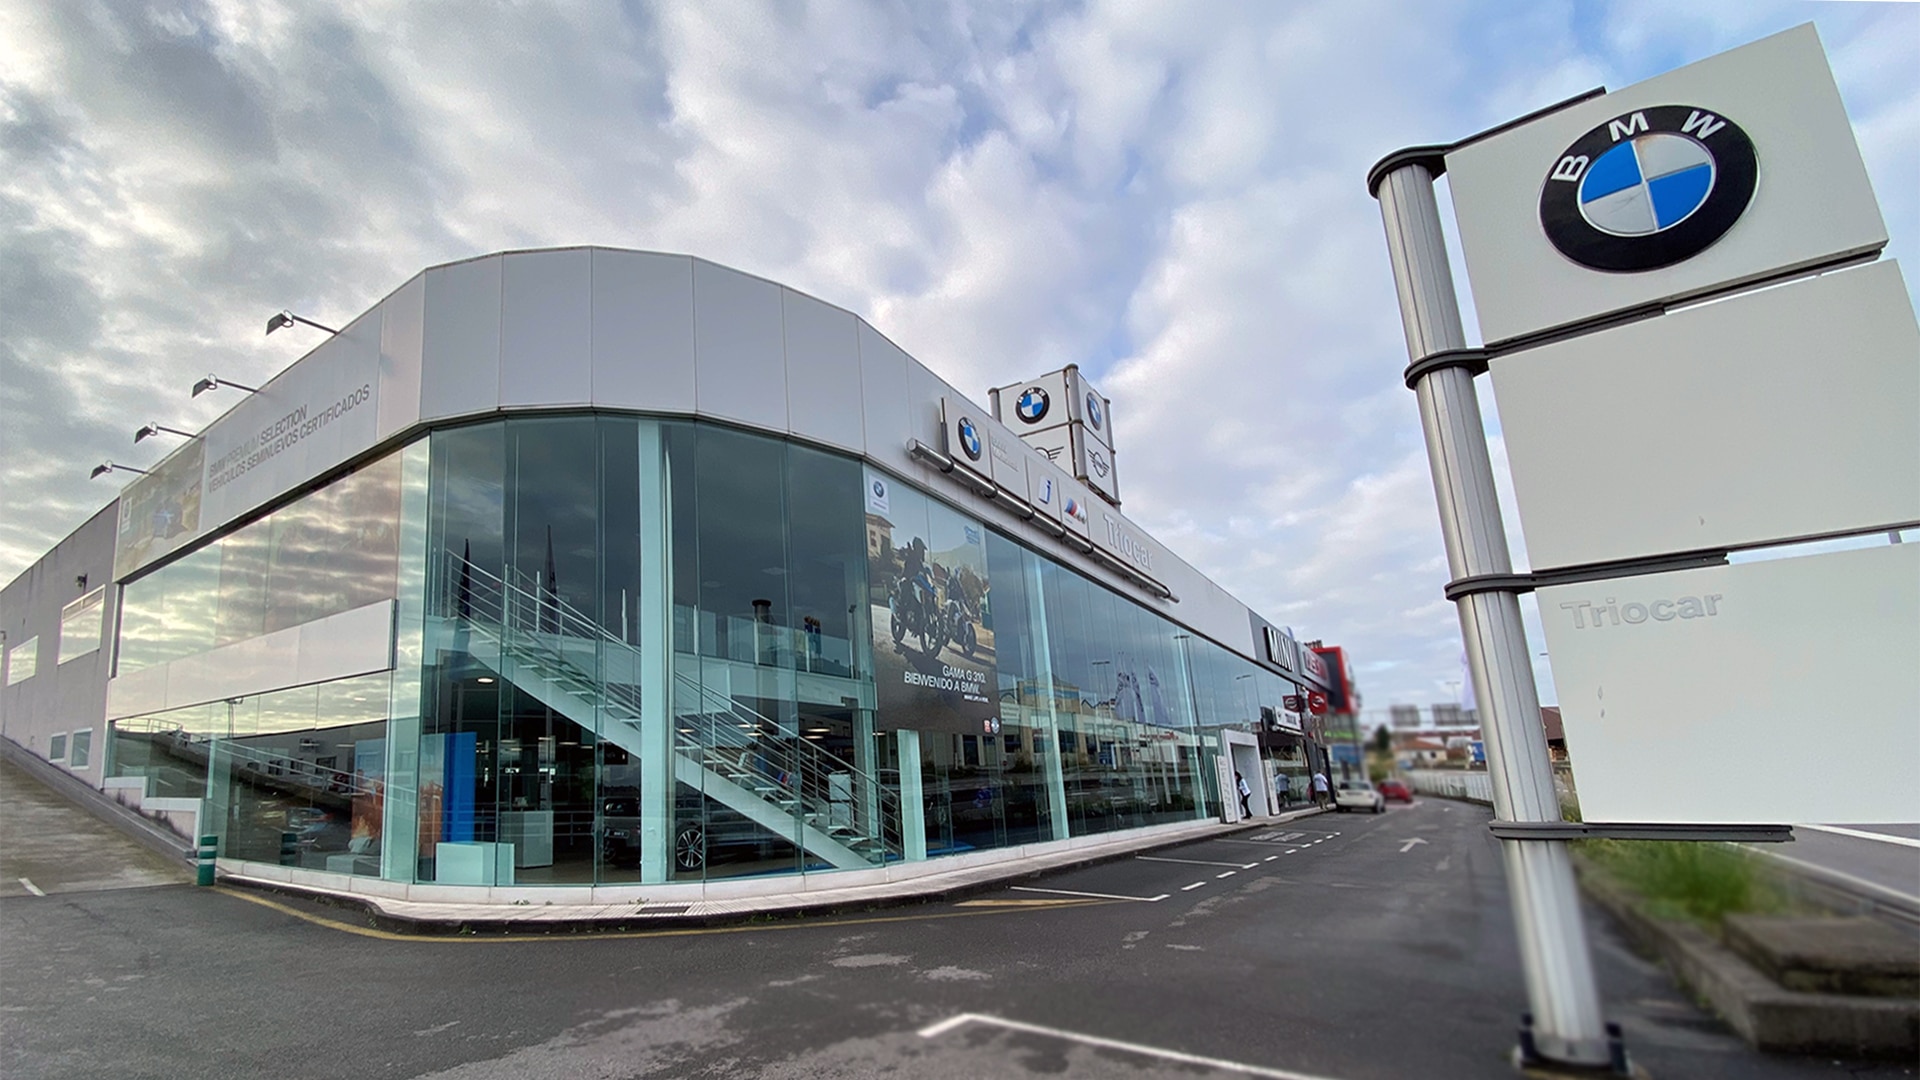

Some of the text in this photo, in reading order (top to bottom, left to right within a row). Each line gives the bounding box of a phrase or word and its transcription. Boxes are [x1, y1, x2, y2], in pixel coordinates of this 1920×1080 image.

[1551, 110, 1726, 182] BMW
[246, 428, 299, 471] SEMINUEVOS
[300, 384, 370, 439] CERTIFICADOS
[260, 404, 308, 446] SELECTION
[1102, 513, 1153, 571] Triocar
[1559, 593, 1722, 629] Triocar
[1265, 626, 1295, 673] MINI
[904, 671, 953, 691] BIENVENIDO
[954, 680, 961, 692] A
[942, 665, 966, 680] GAMA
[966, 669, 973, 682] G
